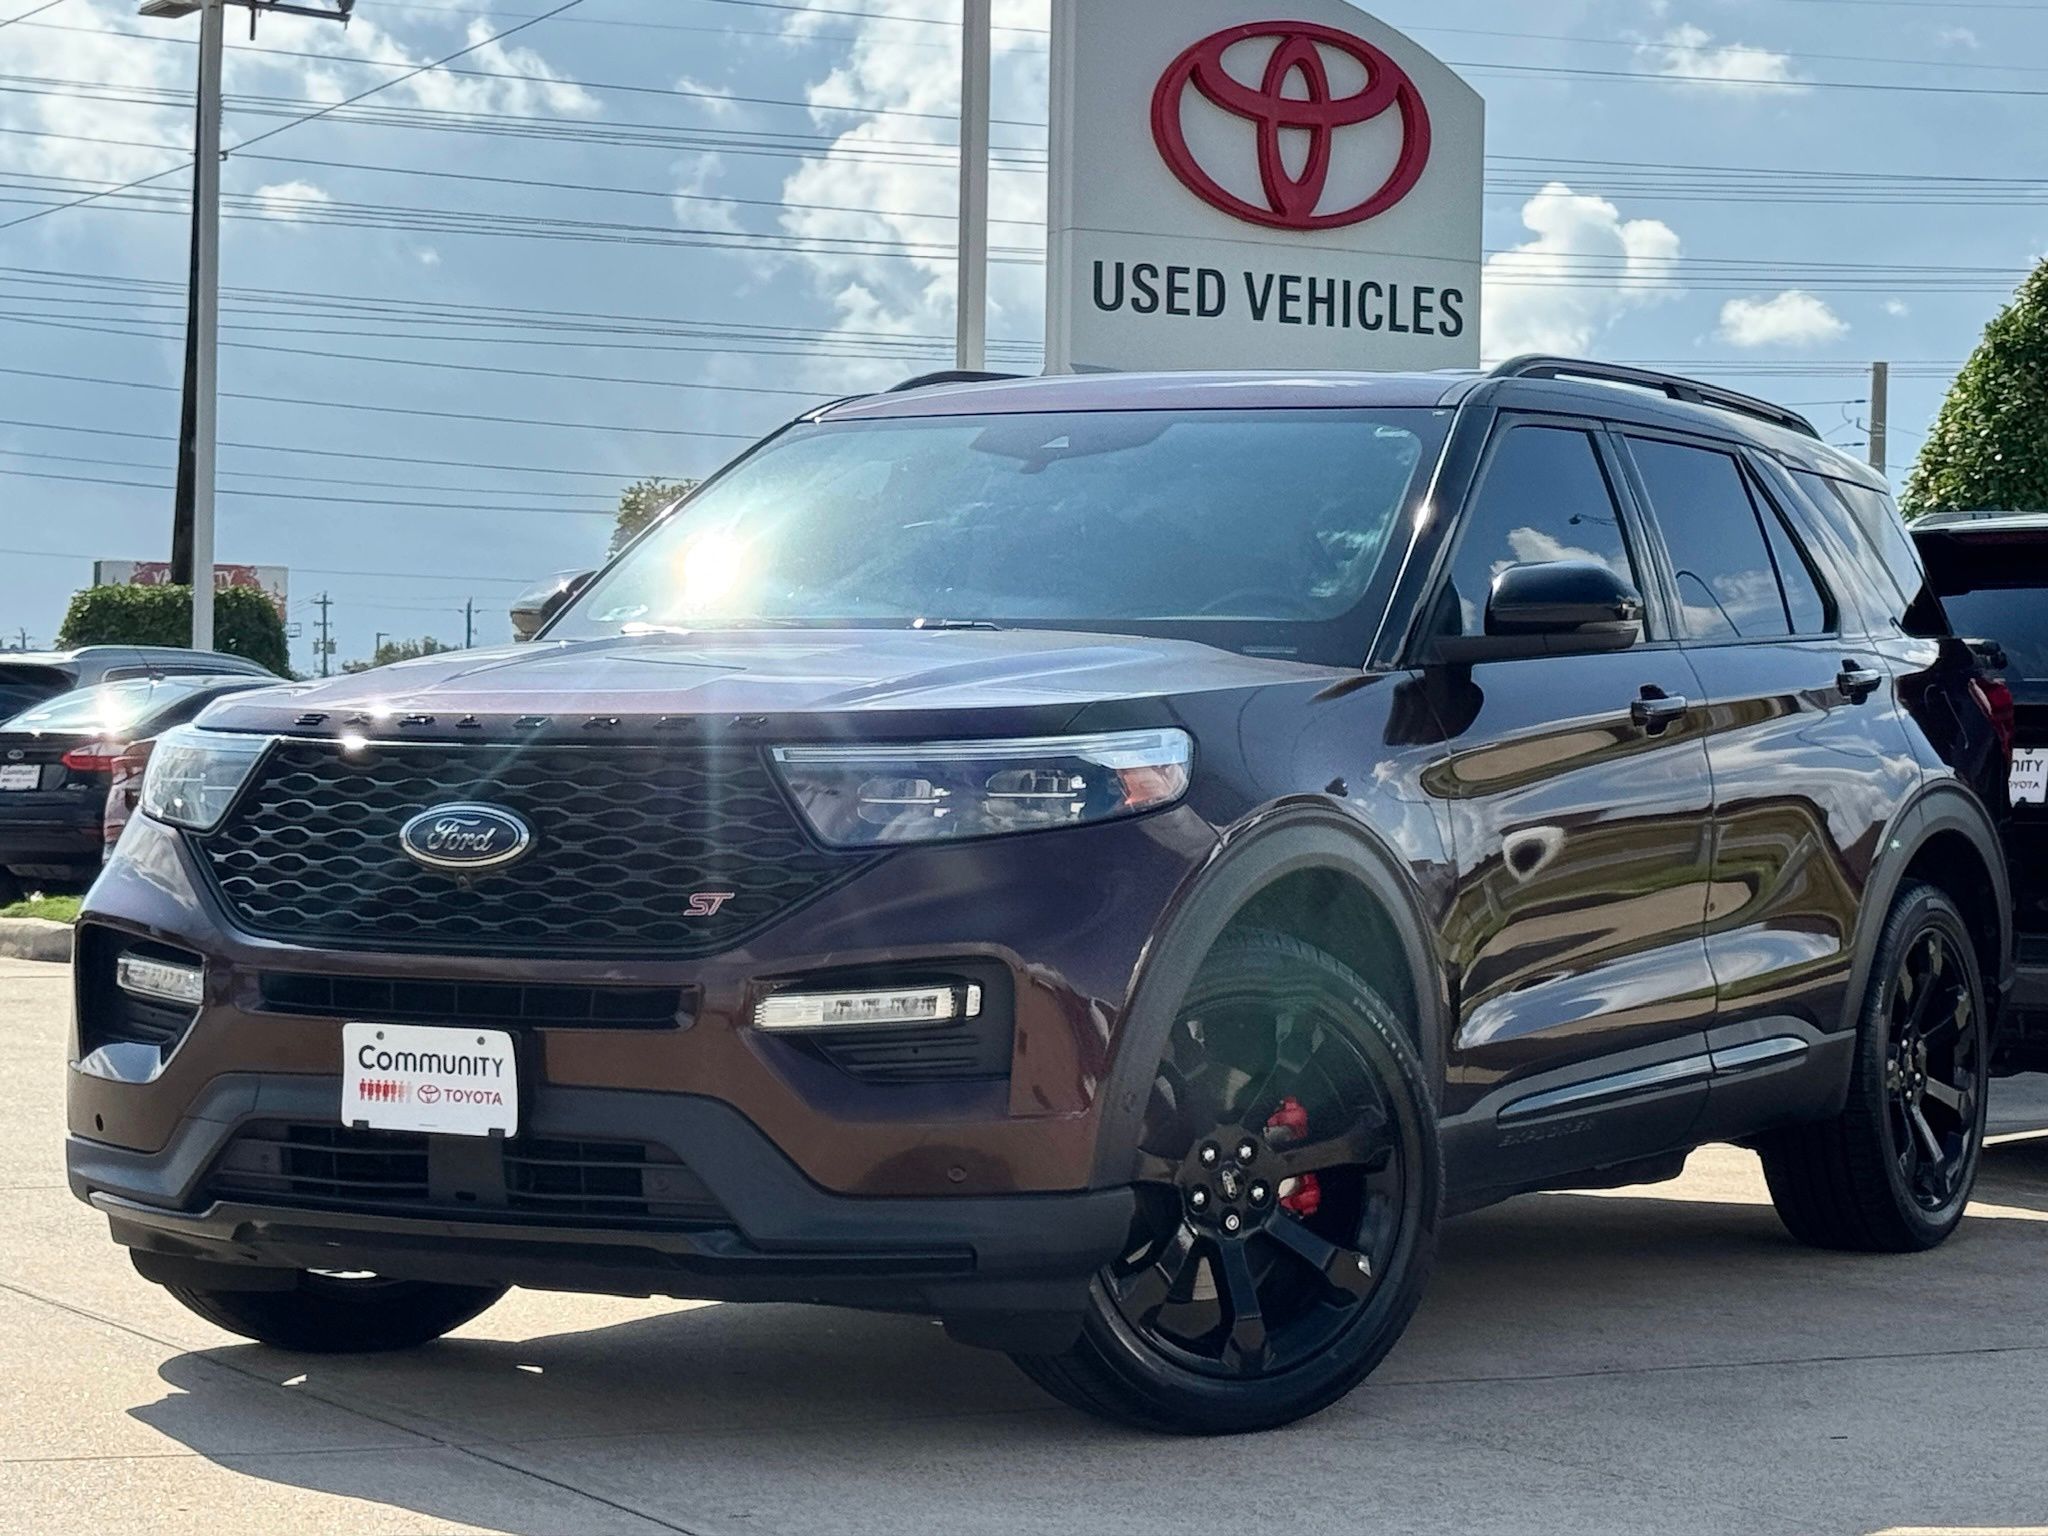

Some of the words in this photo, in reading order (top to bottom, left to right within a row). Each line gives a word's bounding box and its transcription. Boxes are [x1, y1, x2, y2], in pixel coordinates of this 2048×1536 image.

[1093, 261, 1226, 318] USED
[1243, 271, 1464, 338] VEHICLES
[427, 817, 497, 852] Ford
[683, 892, 735, 917] ST
[444, 1088, 503, 1106] TOYOTA
